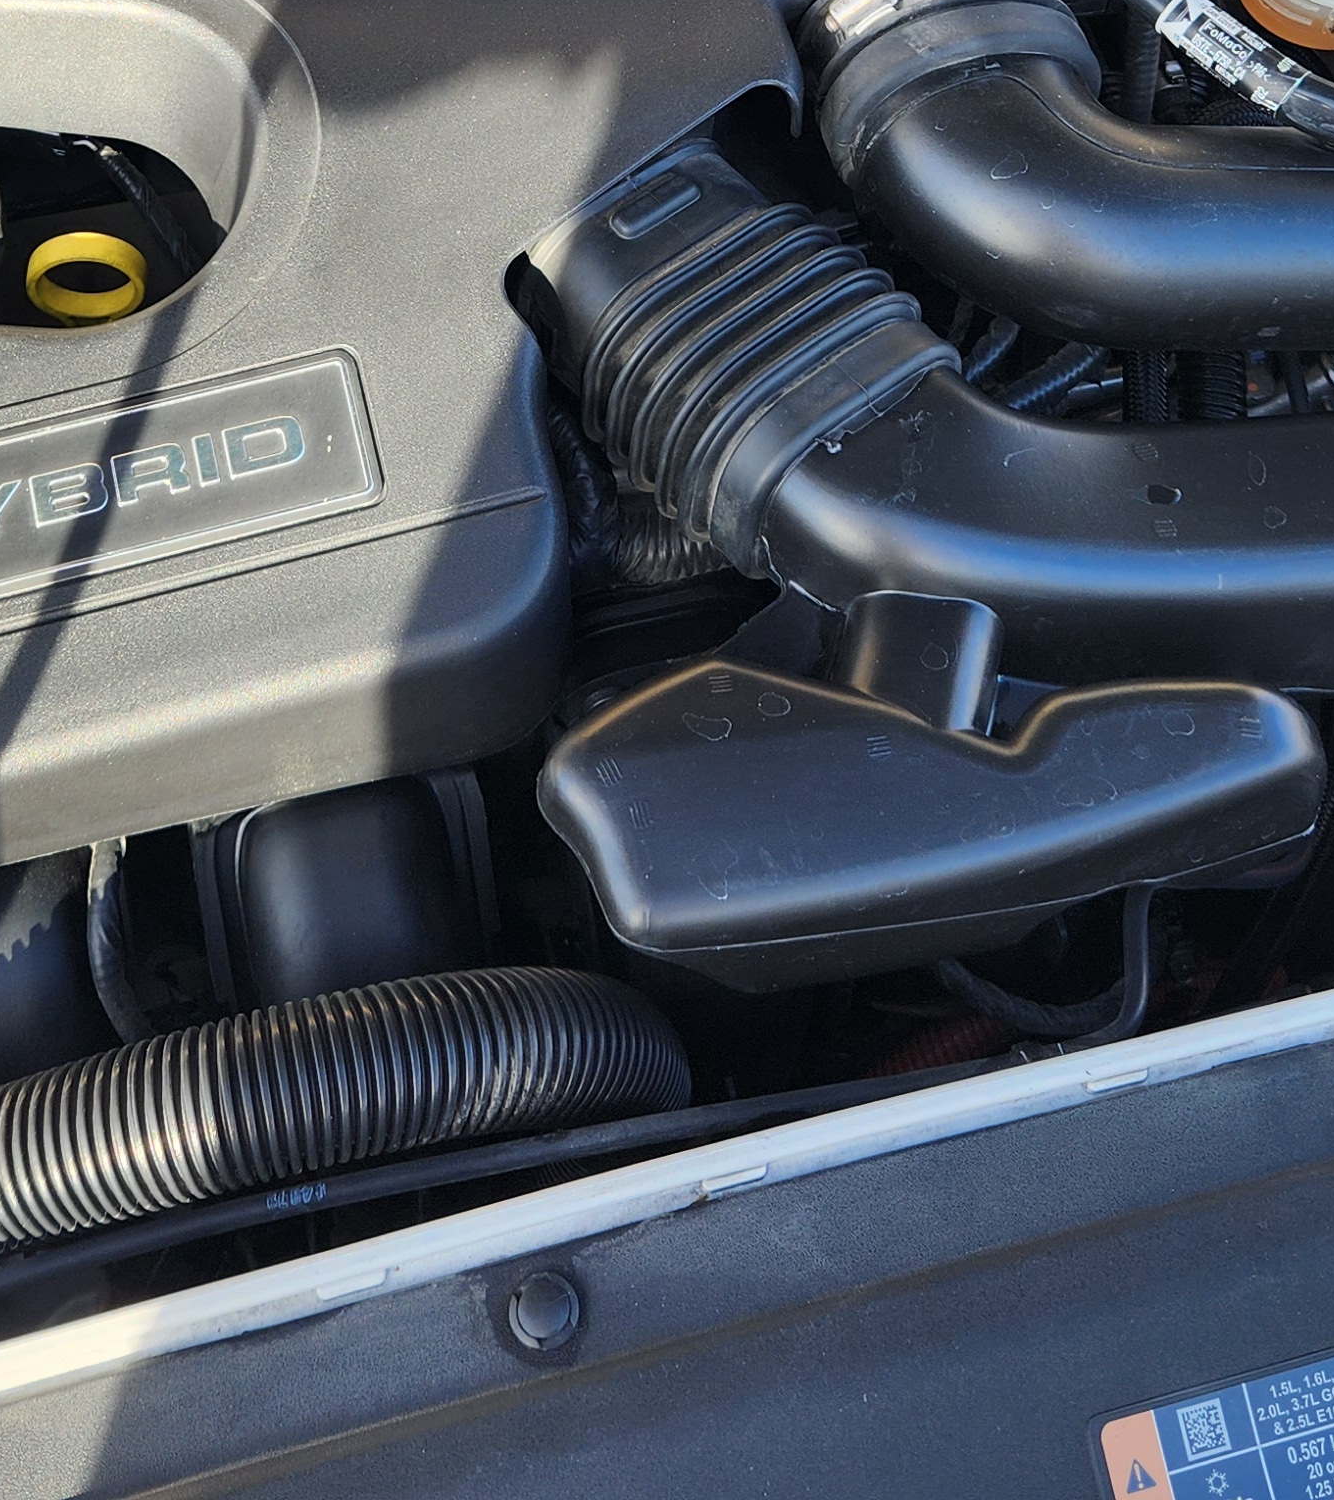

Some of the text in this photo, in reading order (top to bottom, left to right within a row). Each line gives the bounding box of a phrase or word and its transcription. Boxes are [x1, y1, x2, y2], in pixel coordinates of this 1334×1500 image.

[1203, 23, 1248, 60] FoMoCo
[1268, 1378, 1302, 1401] 1.5L,
[1256, 1400, 1290, 1423] 2.0L,
[1290, 1391, 1321, 1412] 3.7L
[1273, 1422, 1285, 1435] &
[1285, 1413, 1315, 1431] 2.5L
[1286, 1437, 1329, 1465] 0.567
[1306, 1462, 1324, 1480] 20
[1304, 1480, 1333, 1500] 1.25
